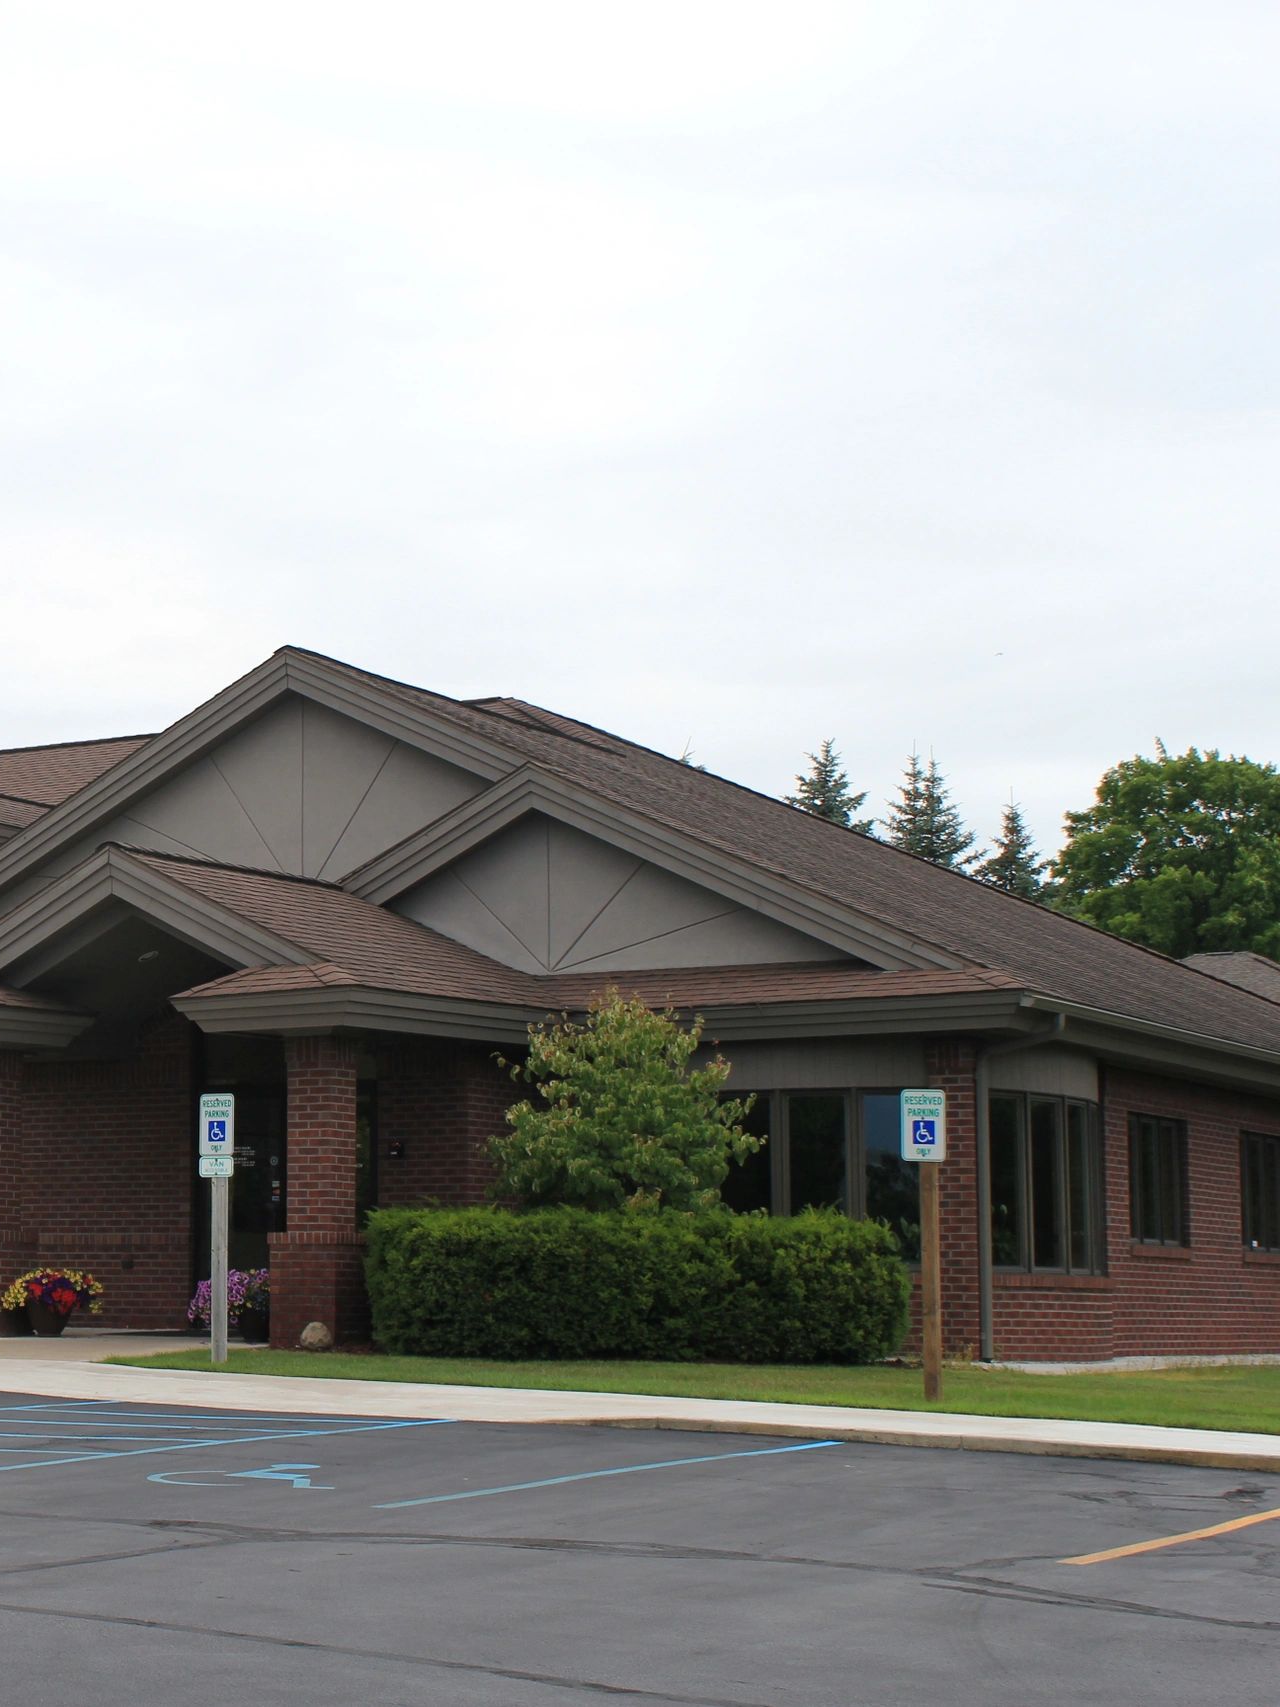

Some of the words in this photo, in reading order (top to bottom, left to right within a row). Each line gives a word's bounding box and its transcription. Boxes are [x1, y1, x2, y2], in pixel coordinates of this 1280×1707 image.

[904, 1096, 942, 1105] RESERVED
[204, 1110, 229, 1118] PARKING
[907, 1108, 939, 1117] PARKING
